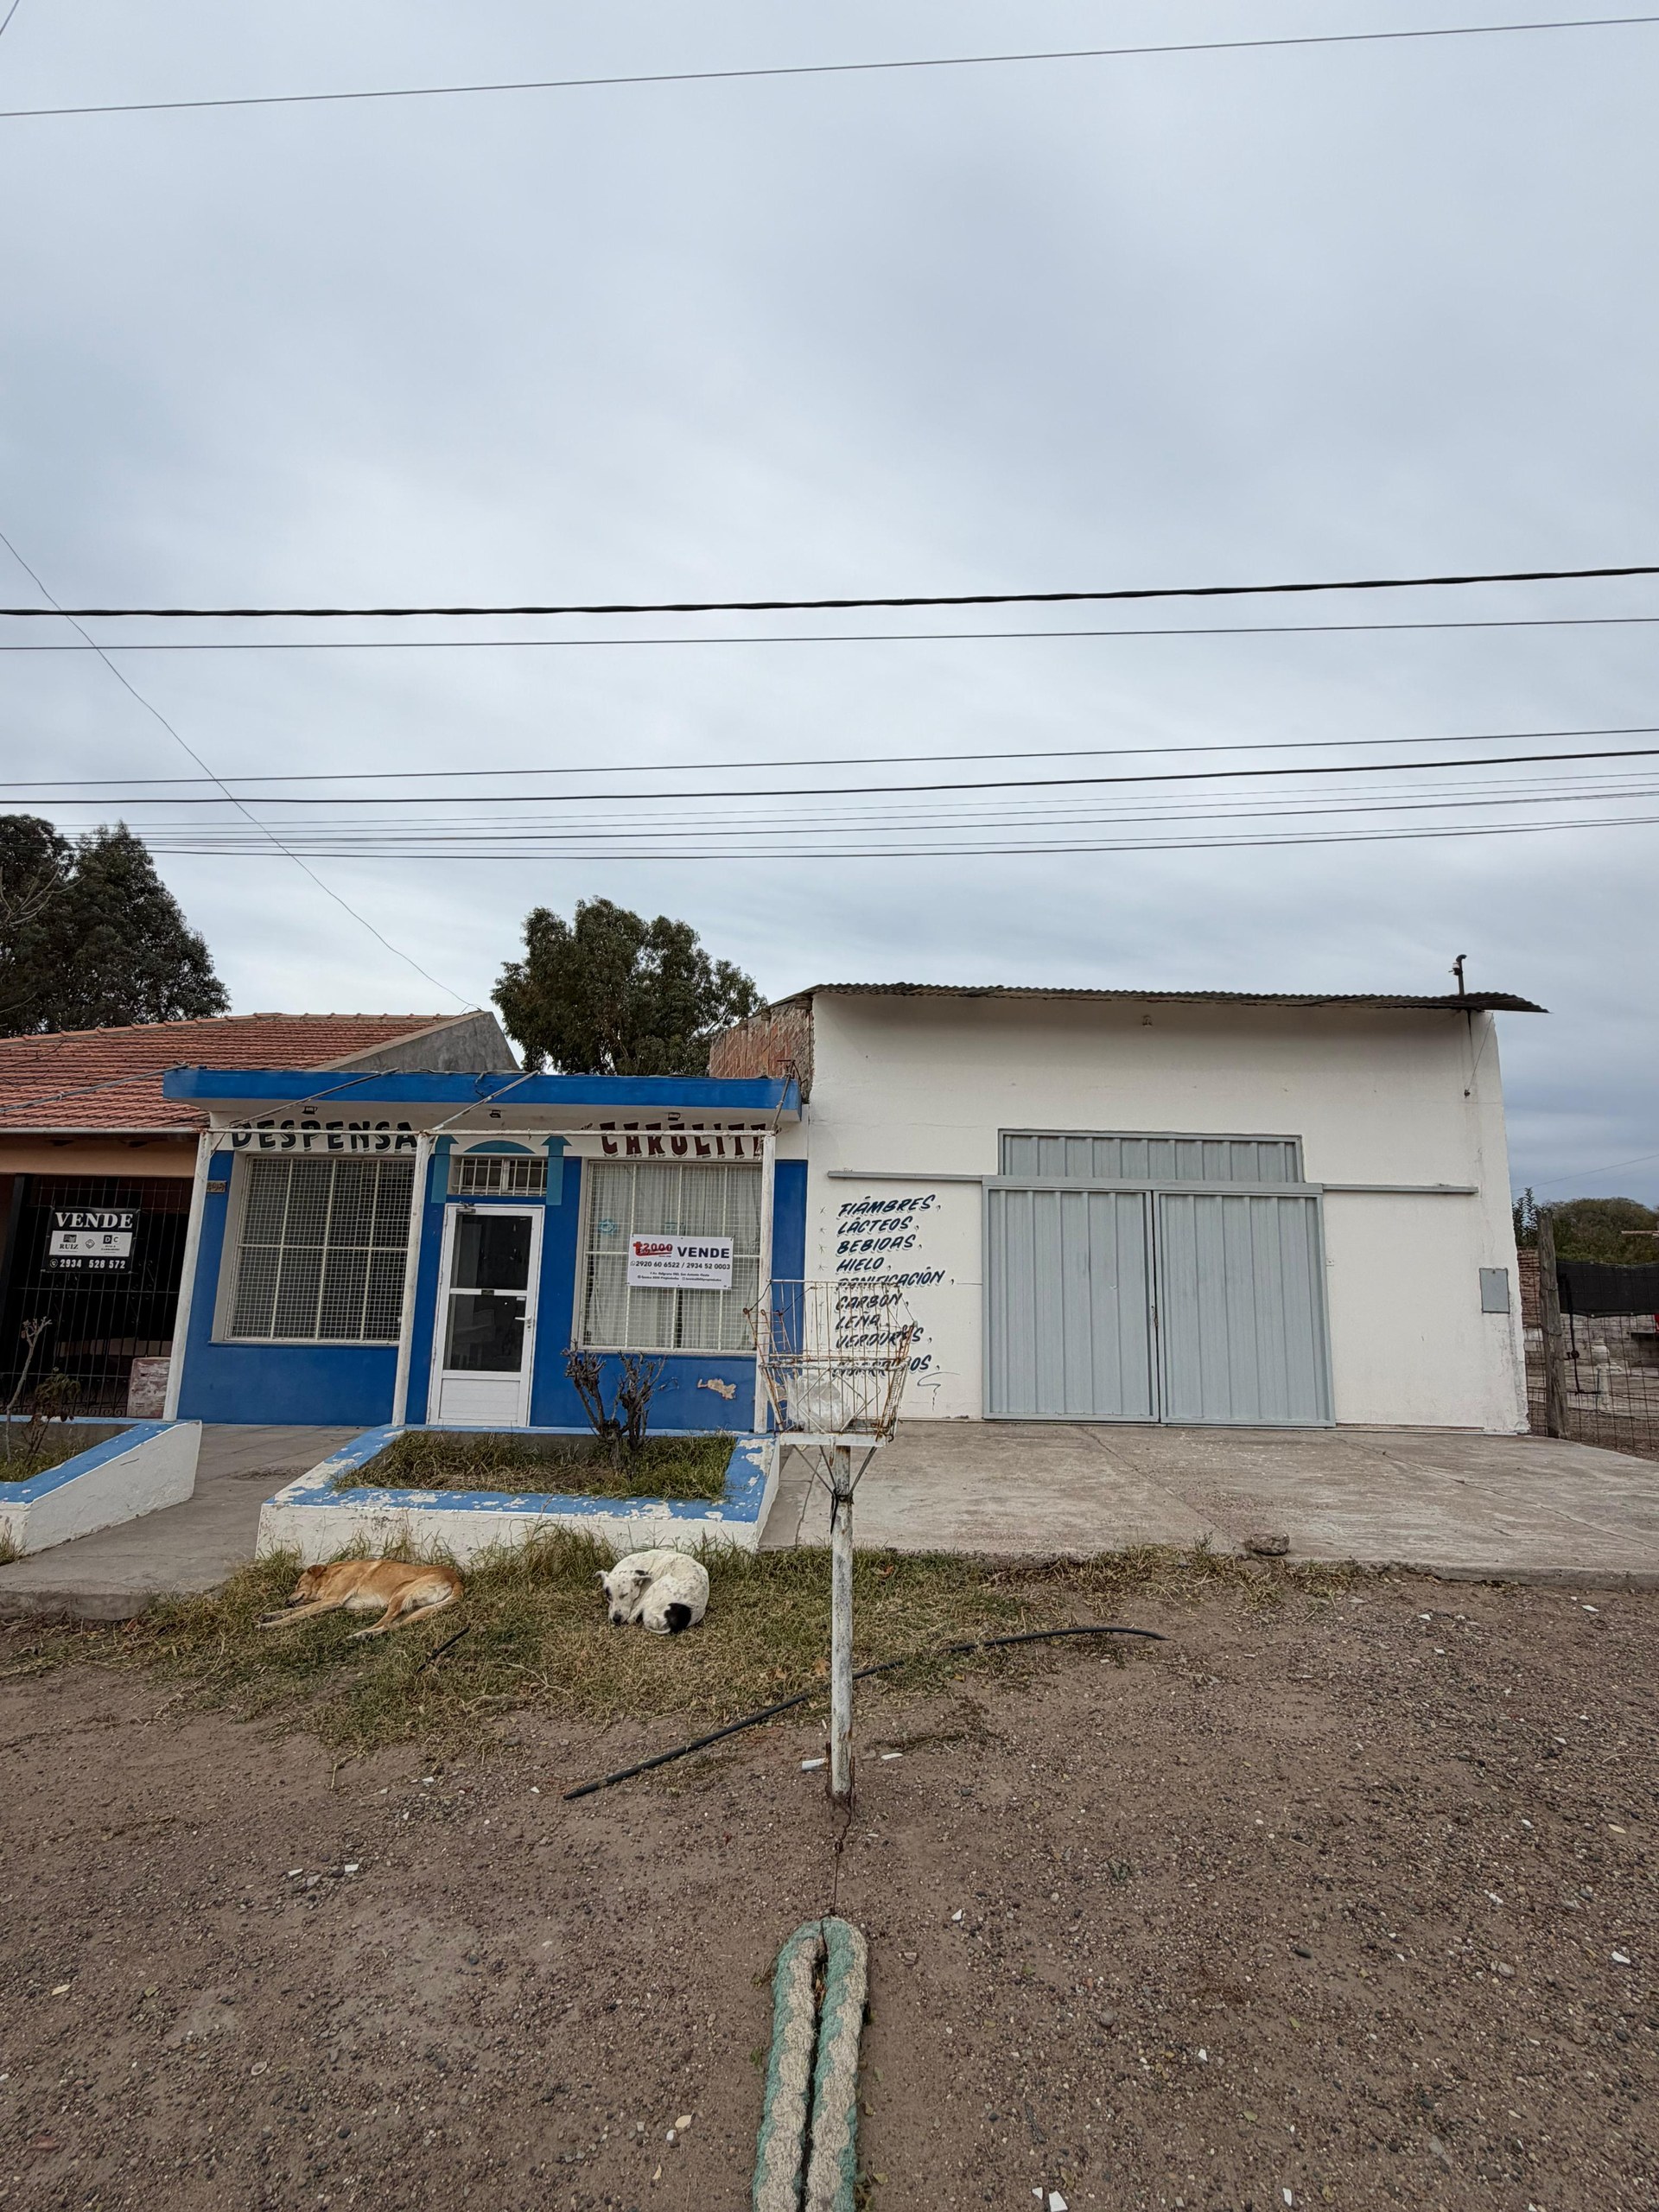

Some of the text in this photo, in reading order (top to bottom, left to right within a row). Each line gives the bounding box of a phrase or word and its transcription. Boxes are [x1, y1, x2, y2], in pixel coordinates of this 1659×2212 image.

[231, 1119, 417, 1151] DESPENSA
[55, 1211, 133, 1228] VENDE
[677, 1246, 730, 1258] VENDE
[59, 1258, 82, 1268] 2934
[109, 1260, 126, 1269] 572
